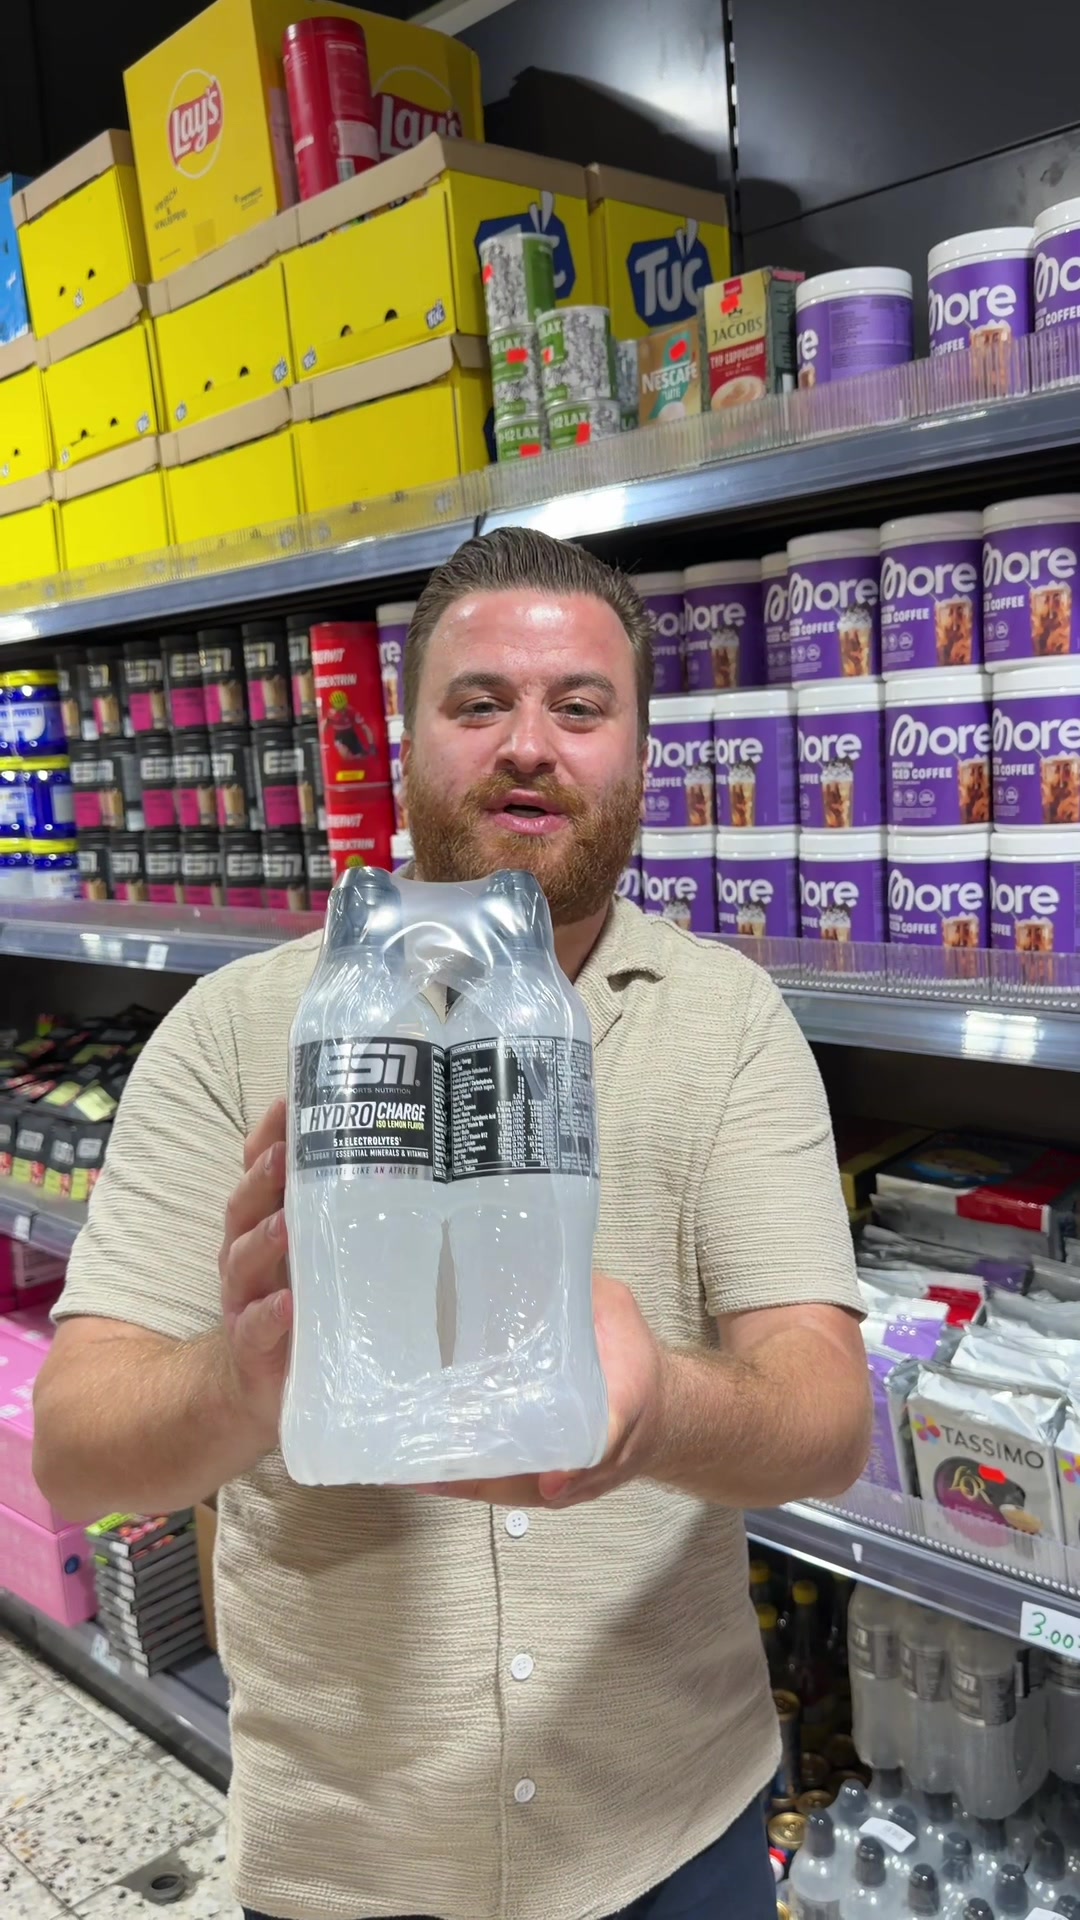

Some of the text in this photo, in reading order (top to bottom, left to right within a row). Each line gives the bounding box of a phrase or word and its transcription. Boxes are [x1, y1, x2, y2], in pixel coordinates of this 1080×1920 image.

[171, 86, 219, 159] Lay's
[634, 246, 704, 317] TUC
[928, 284, 1017, 336] More
[711, 317, 764, 346] JACOBS
[880, 557, 978, 600] More
[981, 542, 1078, 588] More
[788, 572, 879, 615] More
[990, 595, 1025, 611] COFFEE
[801, 621, 835, 636] COFFEE
[893, 607, 930, 623] COFFEE
[889, 713, 991, 757] More
[992, 707, 1080, 752] More
[714, 736, 764, 764] ore
[911, 766, 953, 780] COFFEE
[1001, 763, 1035, 776] COFFEE
[888, 868, 984, 912] More
[902, 921, 937, 935] COFFEE
[316, 1042, 418, 1087] ESN
[375, 1087, 411, 1095] NUTRITION
[309, 1101, 426, 1131] HYDRO CHARGE
[376, 1120, 425, 1131] ISO LEMON FLAVOR
[336, 1149, 368, 1159] ESSENTIAL
[370, 1149, 399, 1157] MINERALS
[407, 1150, 429, 1160] VITAMINS
[352, 1166, 370, 1175] LIKE
[374, 1166, 384, 1174] AN
[389, 1166, 418, 1175] ATHLETE
[940, 1424, 1044, 1469] TASSIMO
